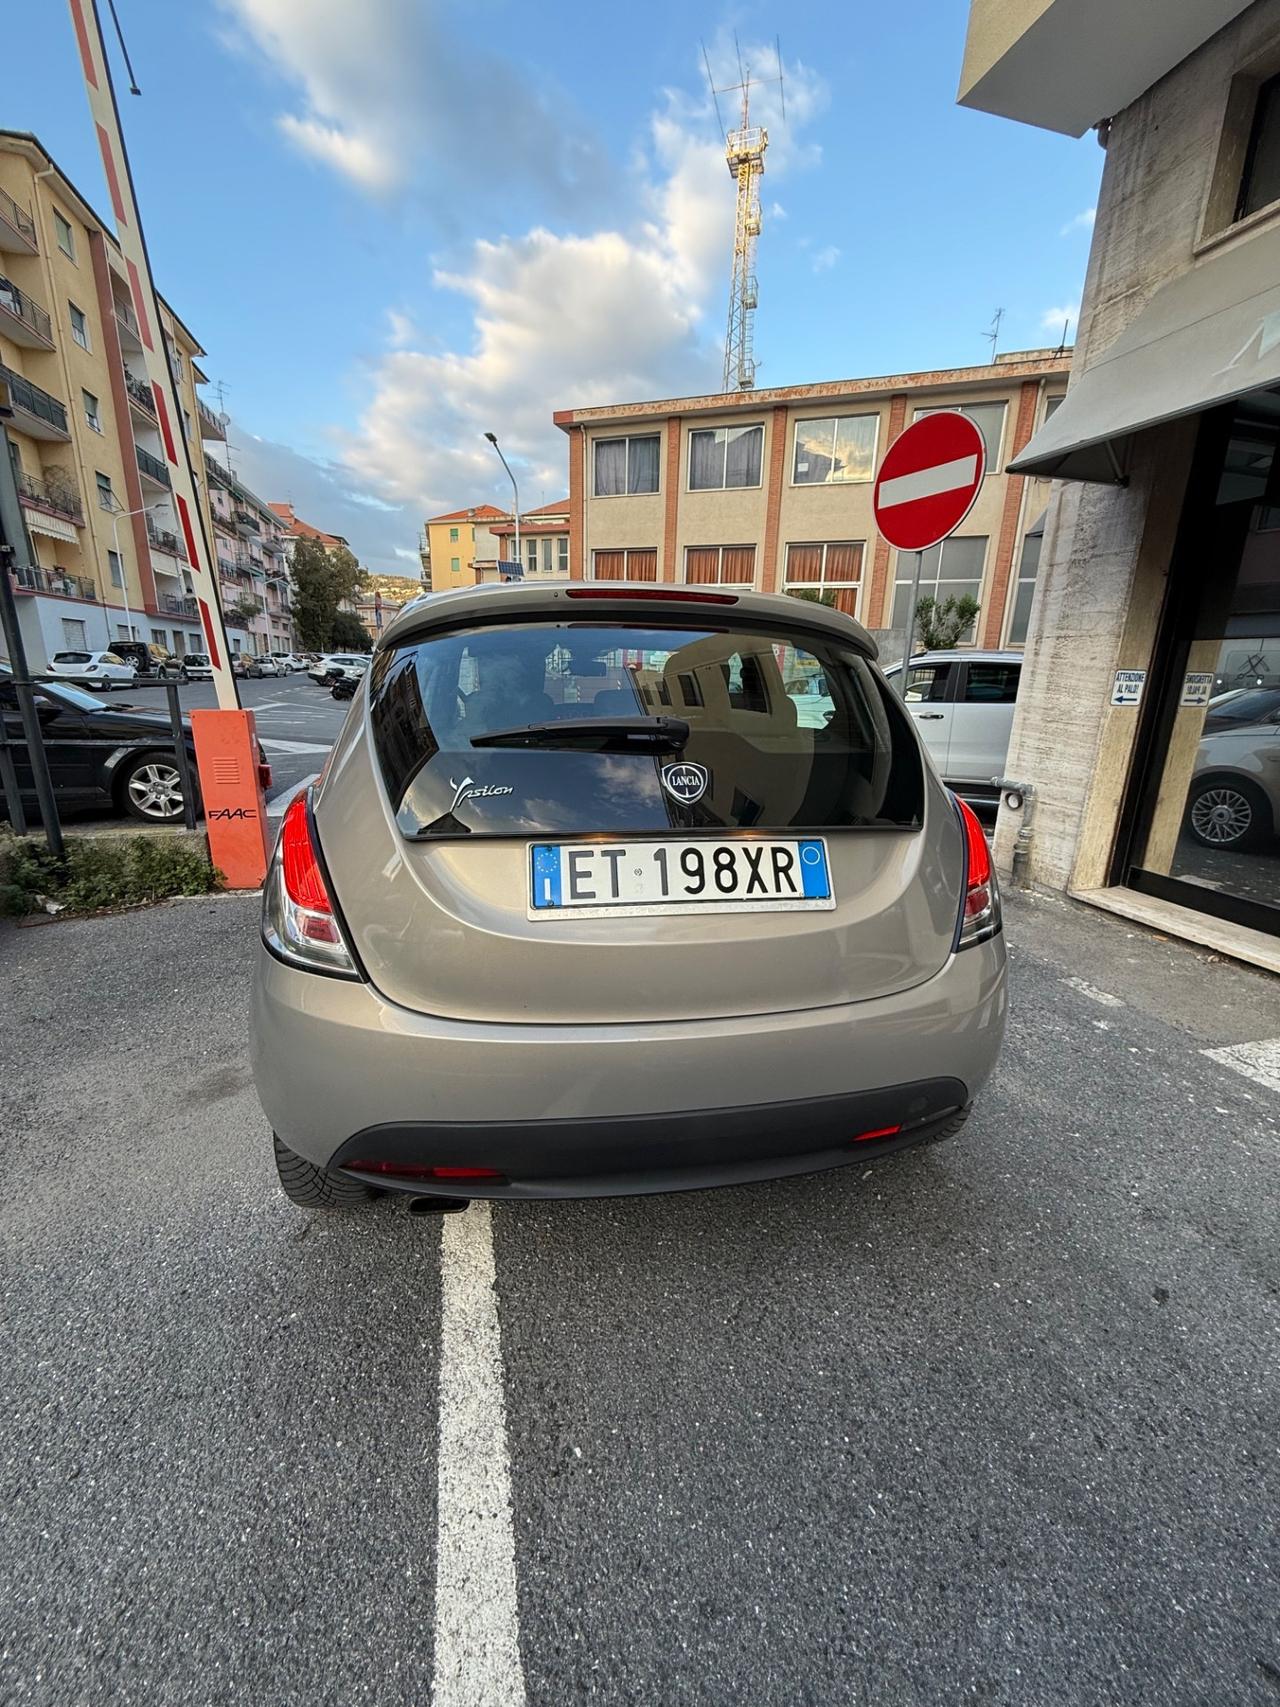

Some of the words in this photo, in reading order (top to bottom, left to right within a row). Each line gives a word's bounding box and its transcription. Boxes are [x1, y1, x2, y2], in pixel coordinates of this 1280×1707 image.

[1116, 672, 1145, 682] ATTENZIONE
[1117, 684, 1123, 693] AL
[672, 775, 700, 785] LANCIA
[450, 776, 514, 812] Ypsilon
[208, 808, 257, 820] FAAC
[568, 849, 626, 900] ET
[653, 846, 798, 896] 198XR
